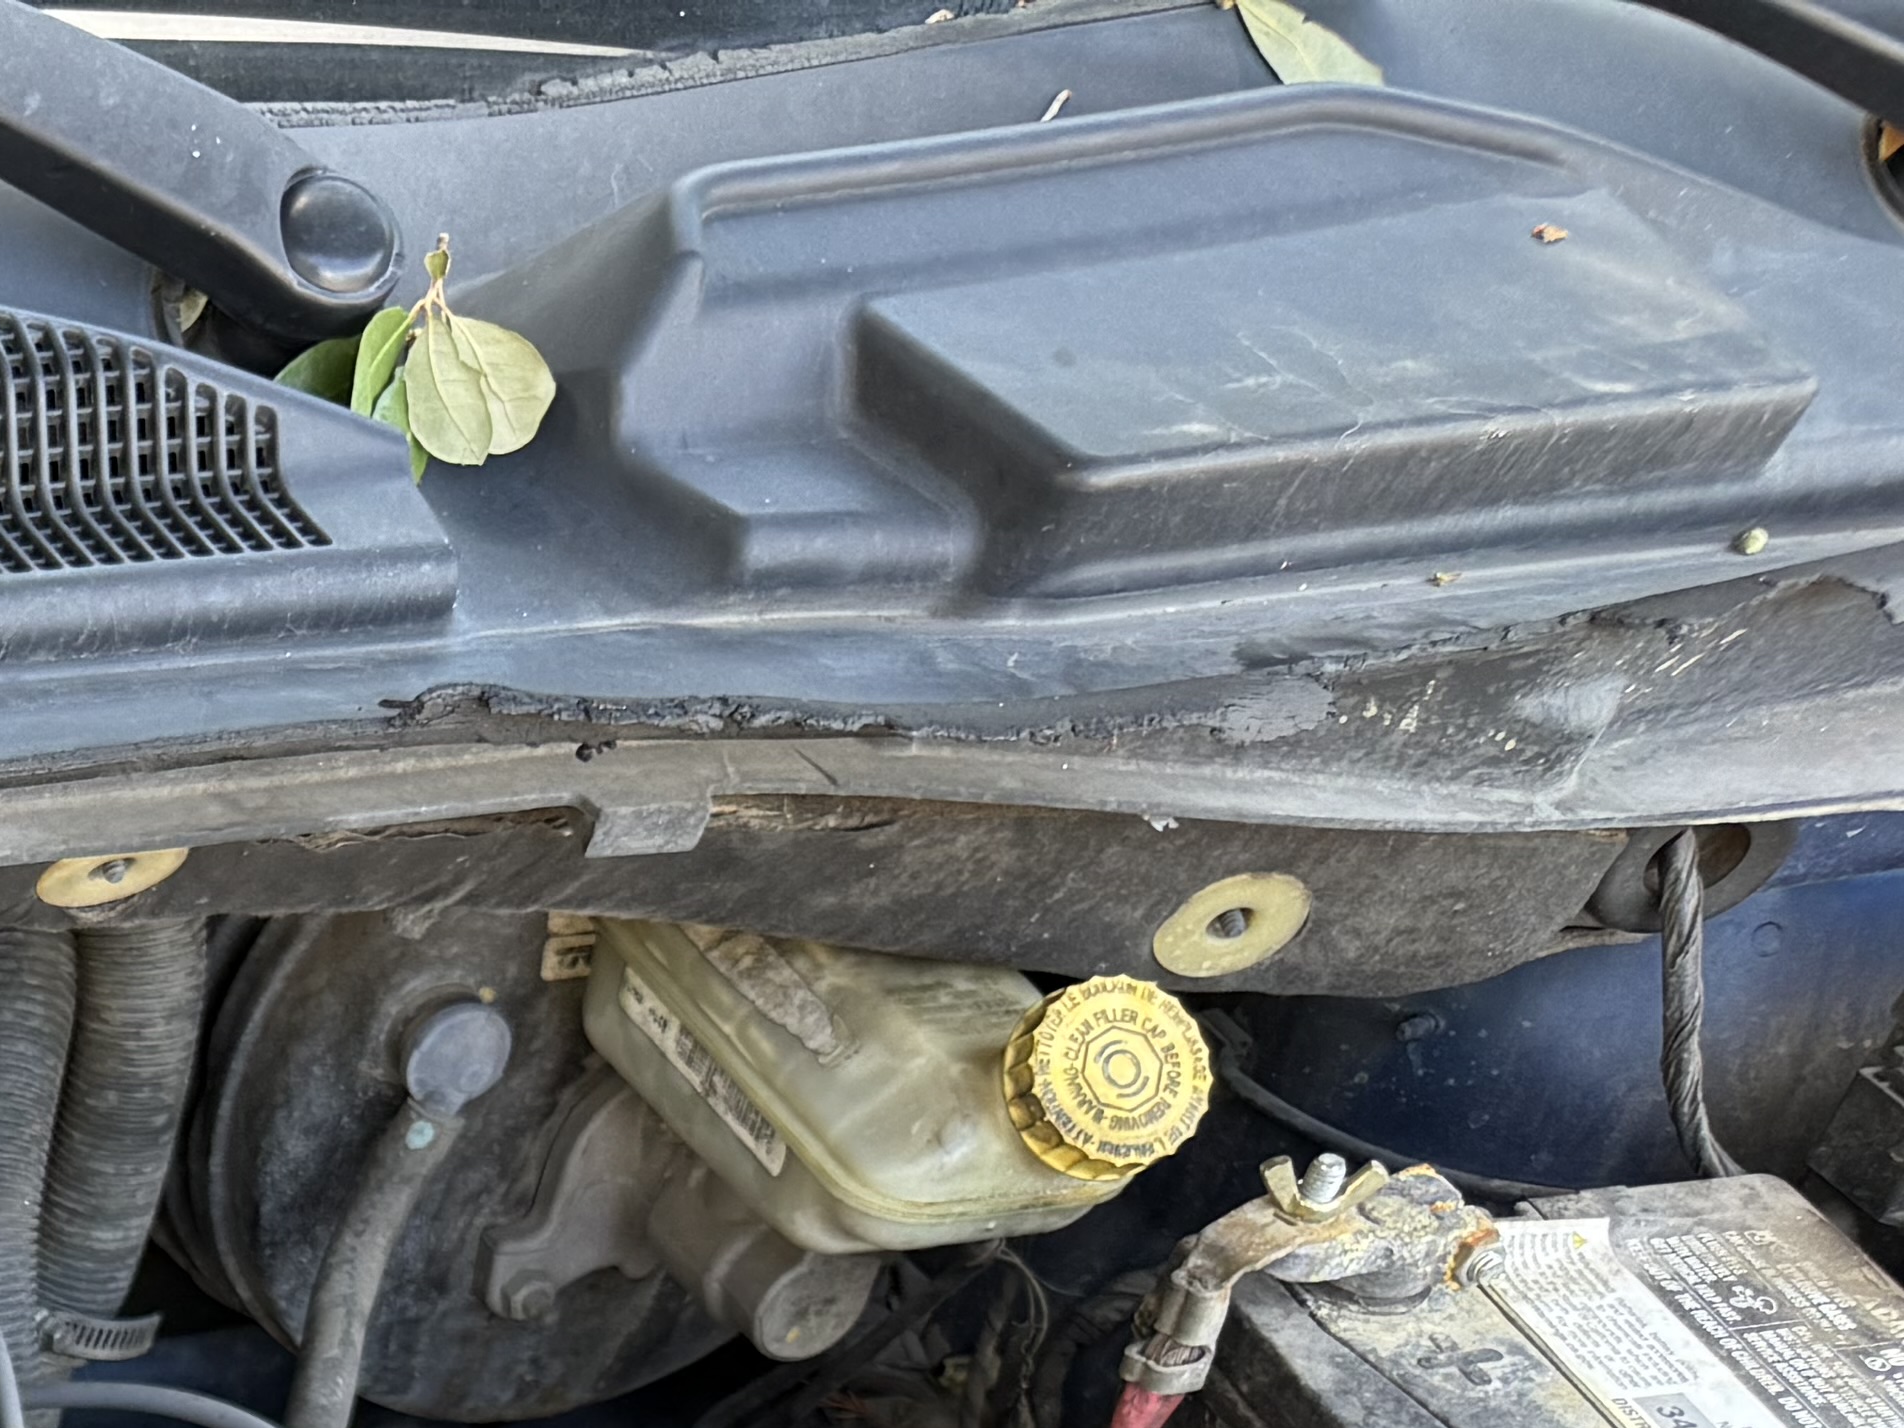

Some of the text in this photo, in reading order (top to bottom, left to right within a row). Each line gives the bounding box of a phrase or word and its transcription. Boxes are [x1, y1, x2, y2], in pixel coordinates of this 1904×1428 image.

[1094, 1008, 1138, 1026] FILLER
[1142, 1017, 1166, 1039] CAP
[1161, 1043, 1181, 1098] BEFORE
[1672, 1292, 1703, 1310] THE
[1687, 1309, 1731, 1338] REACH
[1815, 1302, 1859, 1330] GASES
[1716, 1337, 1743, 1350] OF
[1740, 1331, 1783, 1362] SERVICE
[1728, 1349, 1789, 1396] CHILDREN.
[1776, 1396, 1805, 1411] DO
[1789, 1409, 1823, 1428] NOT
